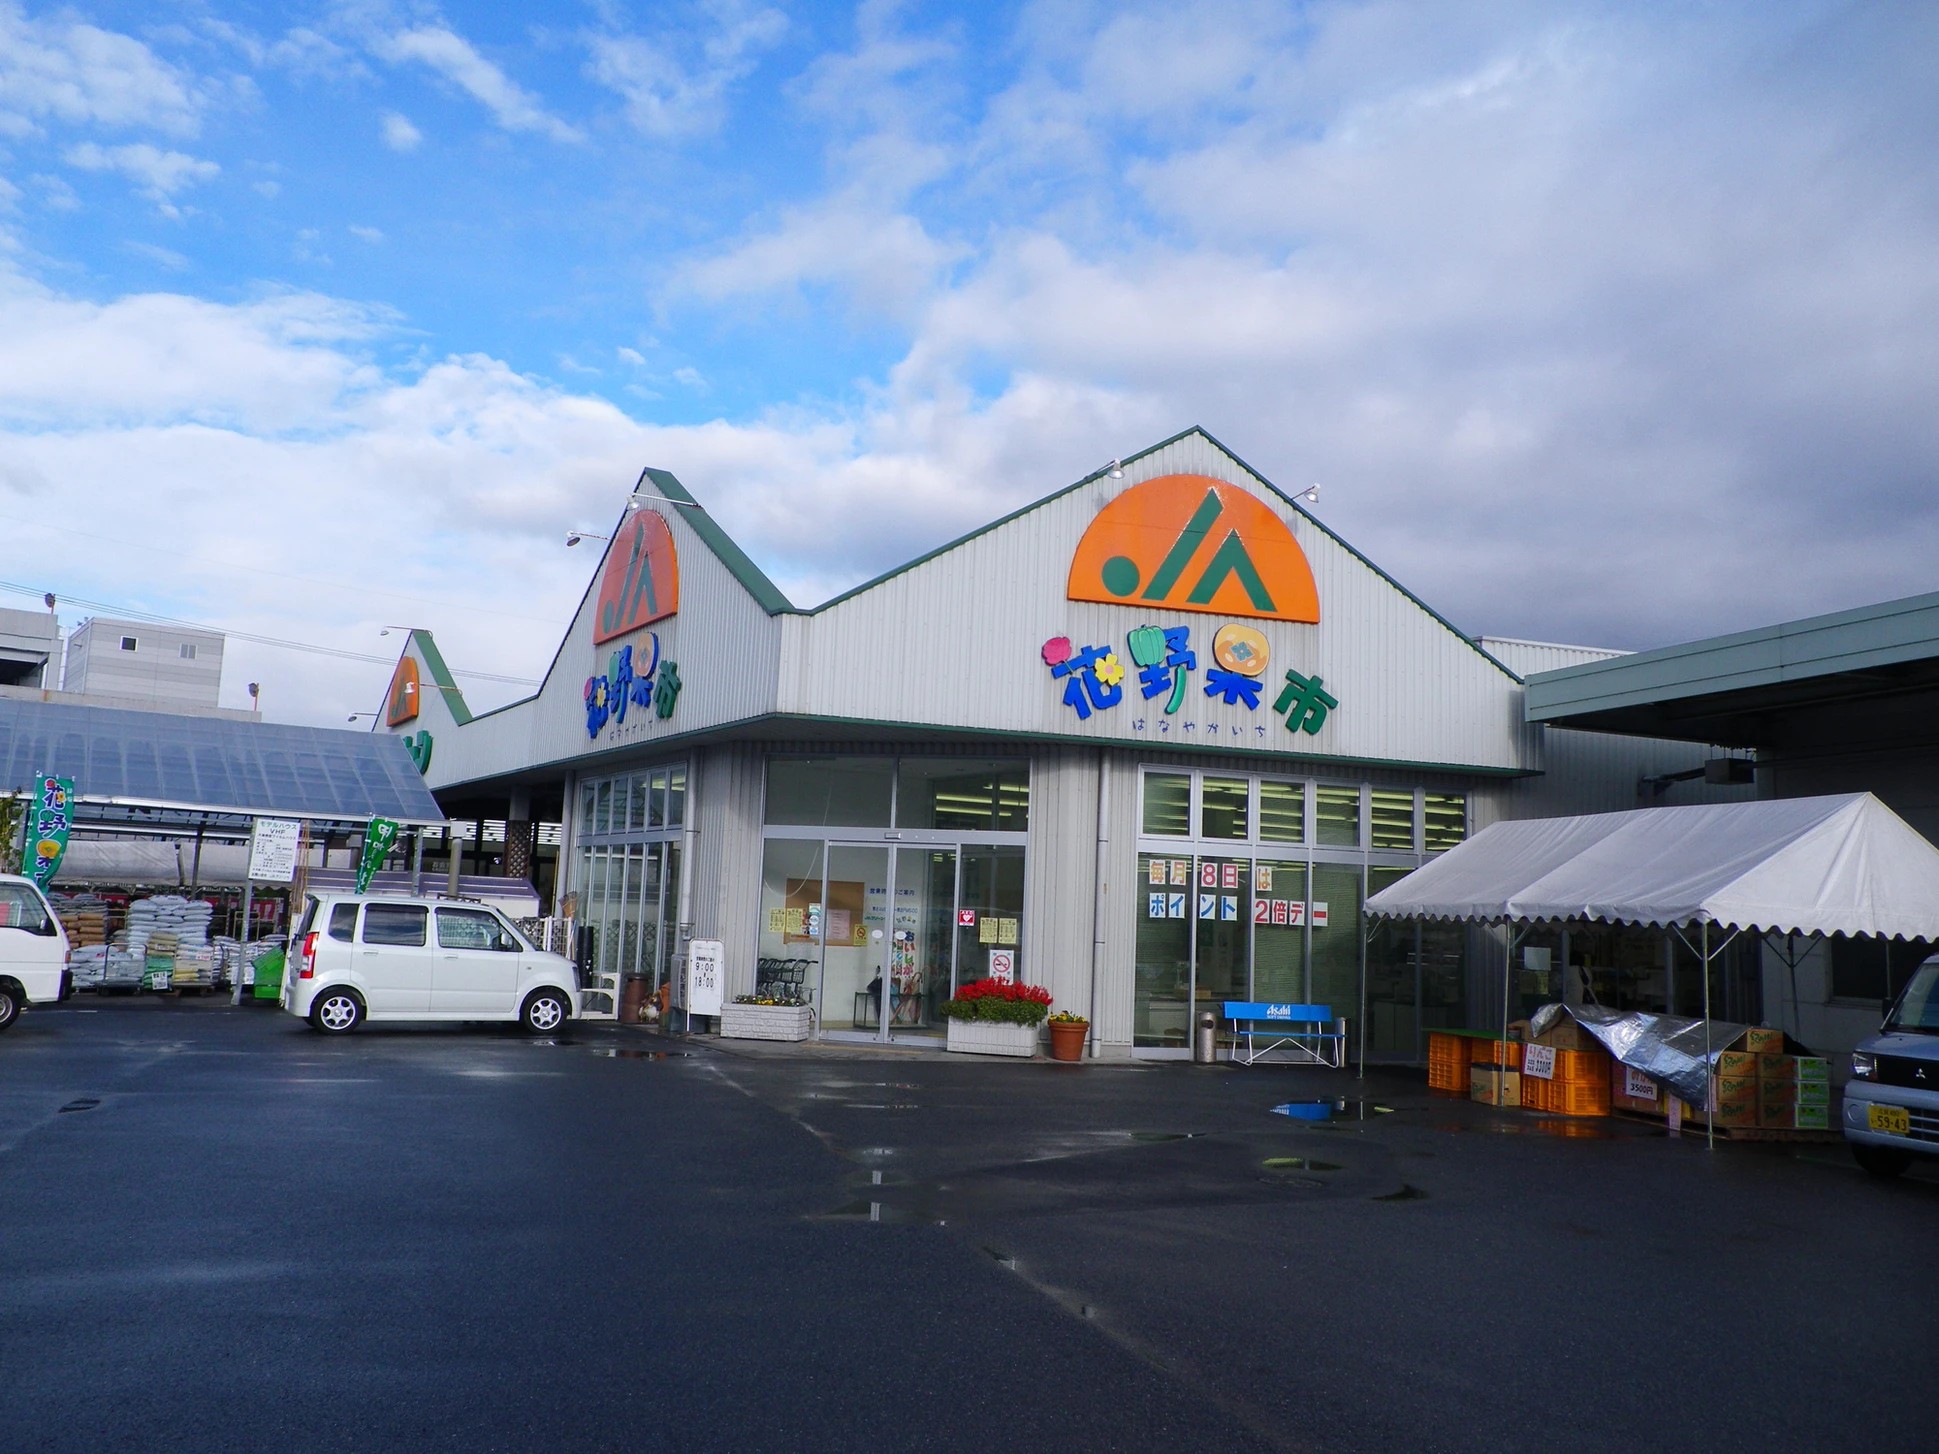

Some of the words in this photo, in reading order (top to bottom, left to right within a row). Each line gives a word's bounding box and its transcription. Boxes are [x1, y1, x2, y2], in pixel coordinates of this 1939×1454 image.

[1133, 718, 1266, 738] はなやかいち
[261, 821, 297, 829] モデルハウス
[695, 962, 715, 972] 9:00
[694, 976, 714, 988] 18:00
[1266, 1004, 1291, 1015] Asahi
